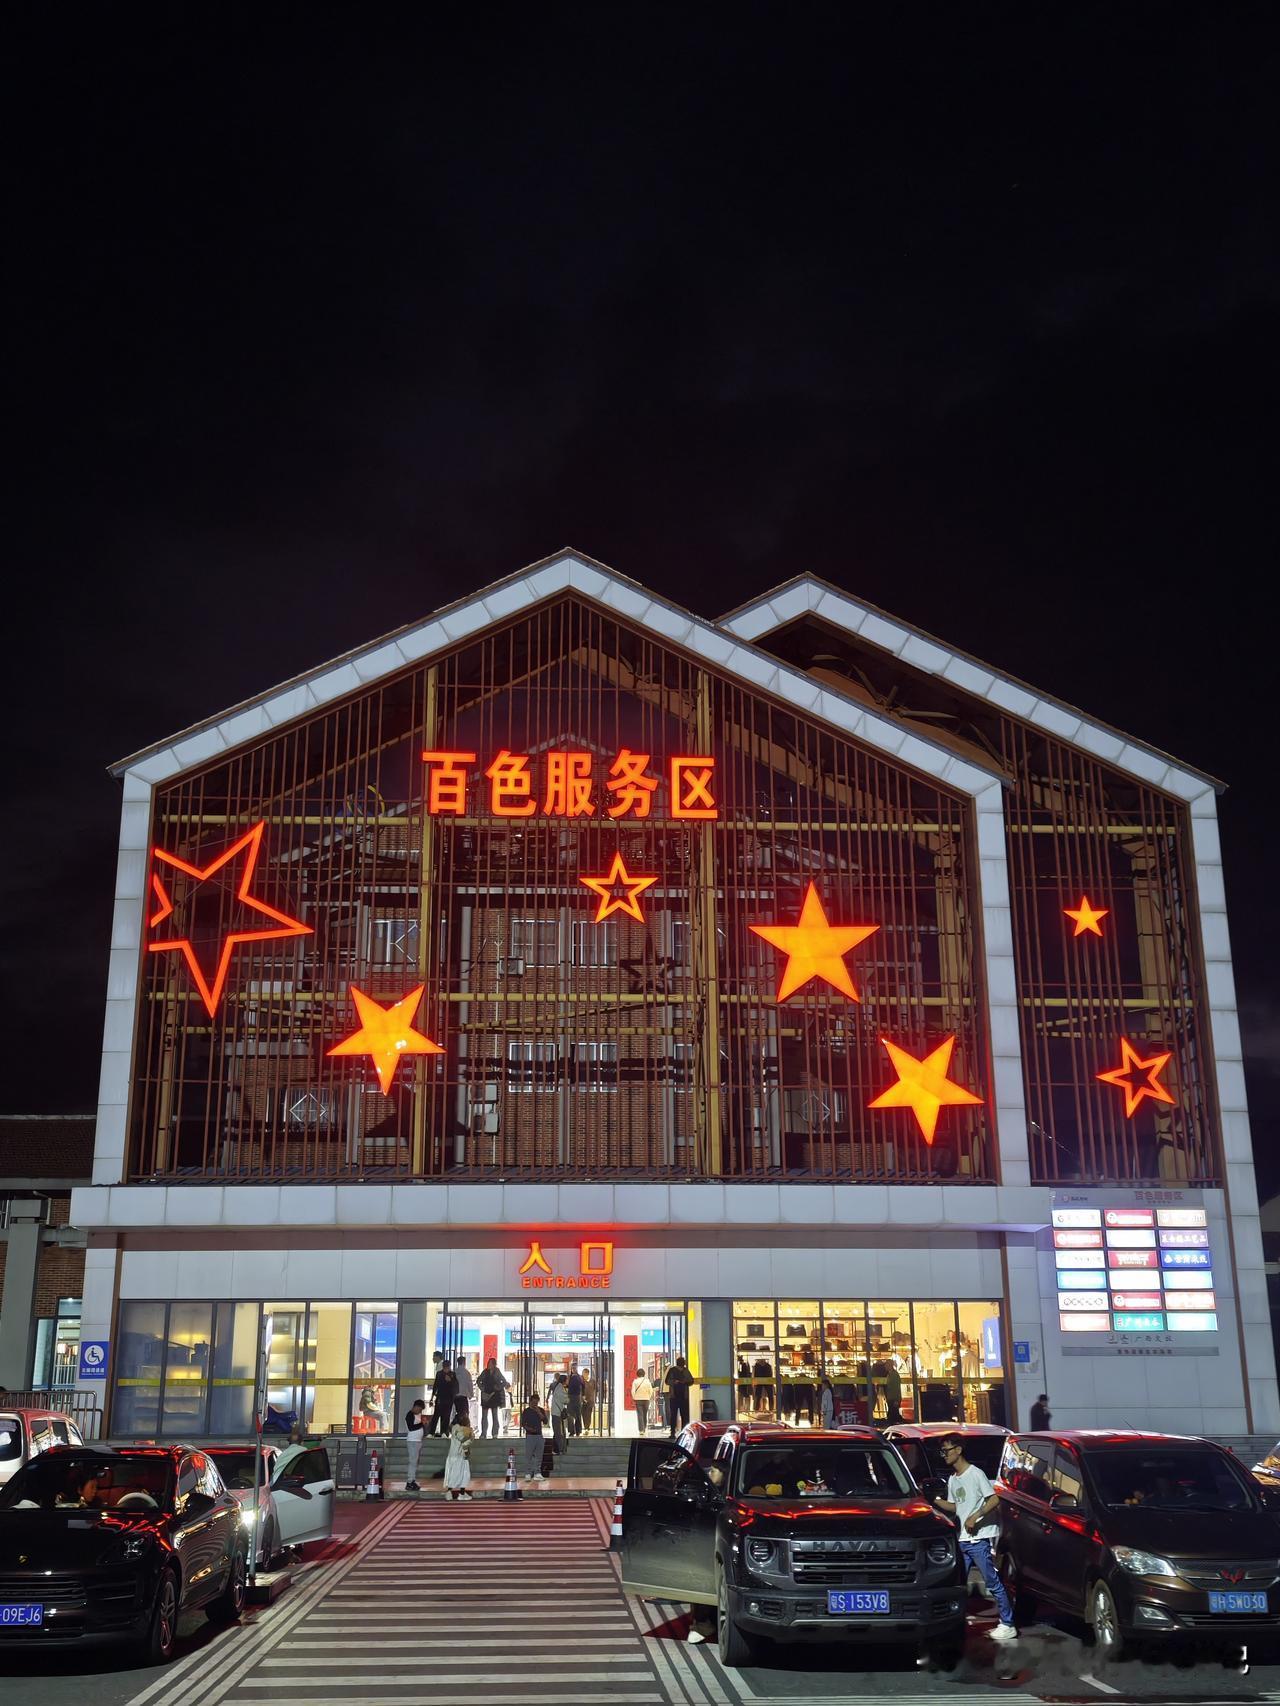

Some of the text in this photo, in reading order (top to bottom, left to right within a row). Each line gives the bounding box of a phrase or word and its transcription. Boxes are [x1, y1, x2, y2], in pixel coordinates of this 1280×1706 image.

[422, 750, 718, 818] 百色服务区
[519, 1242, 613, 1275] 入口
[522, 1277, 610, 1288] ENTRANCE
[812, 1541, 898, 1552] HAVAL
